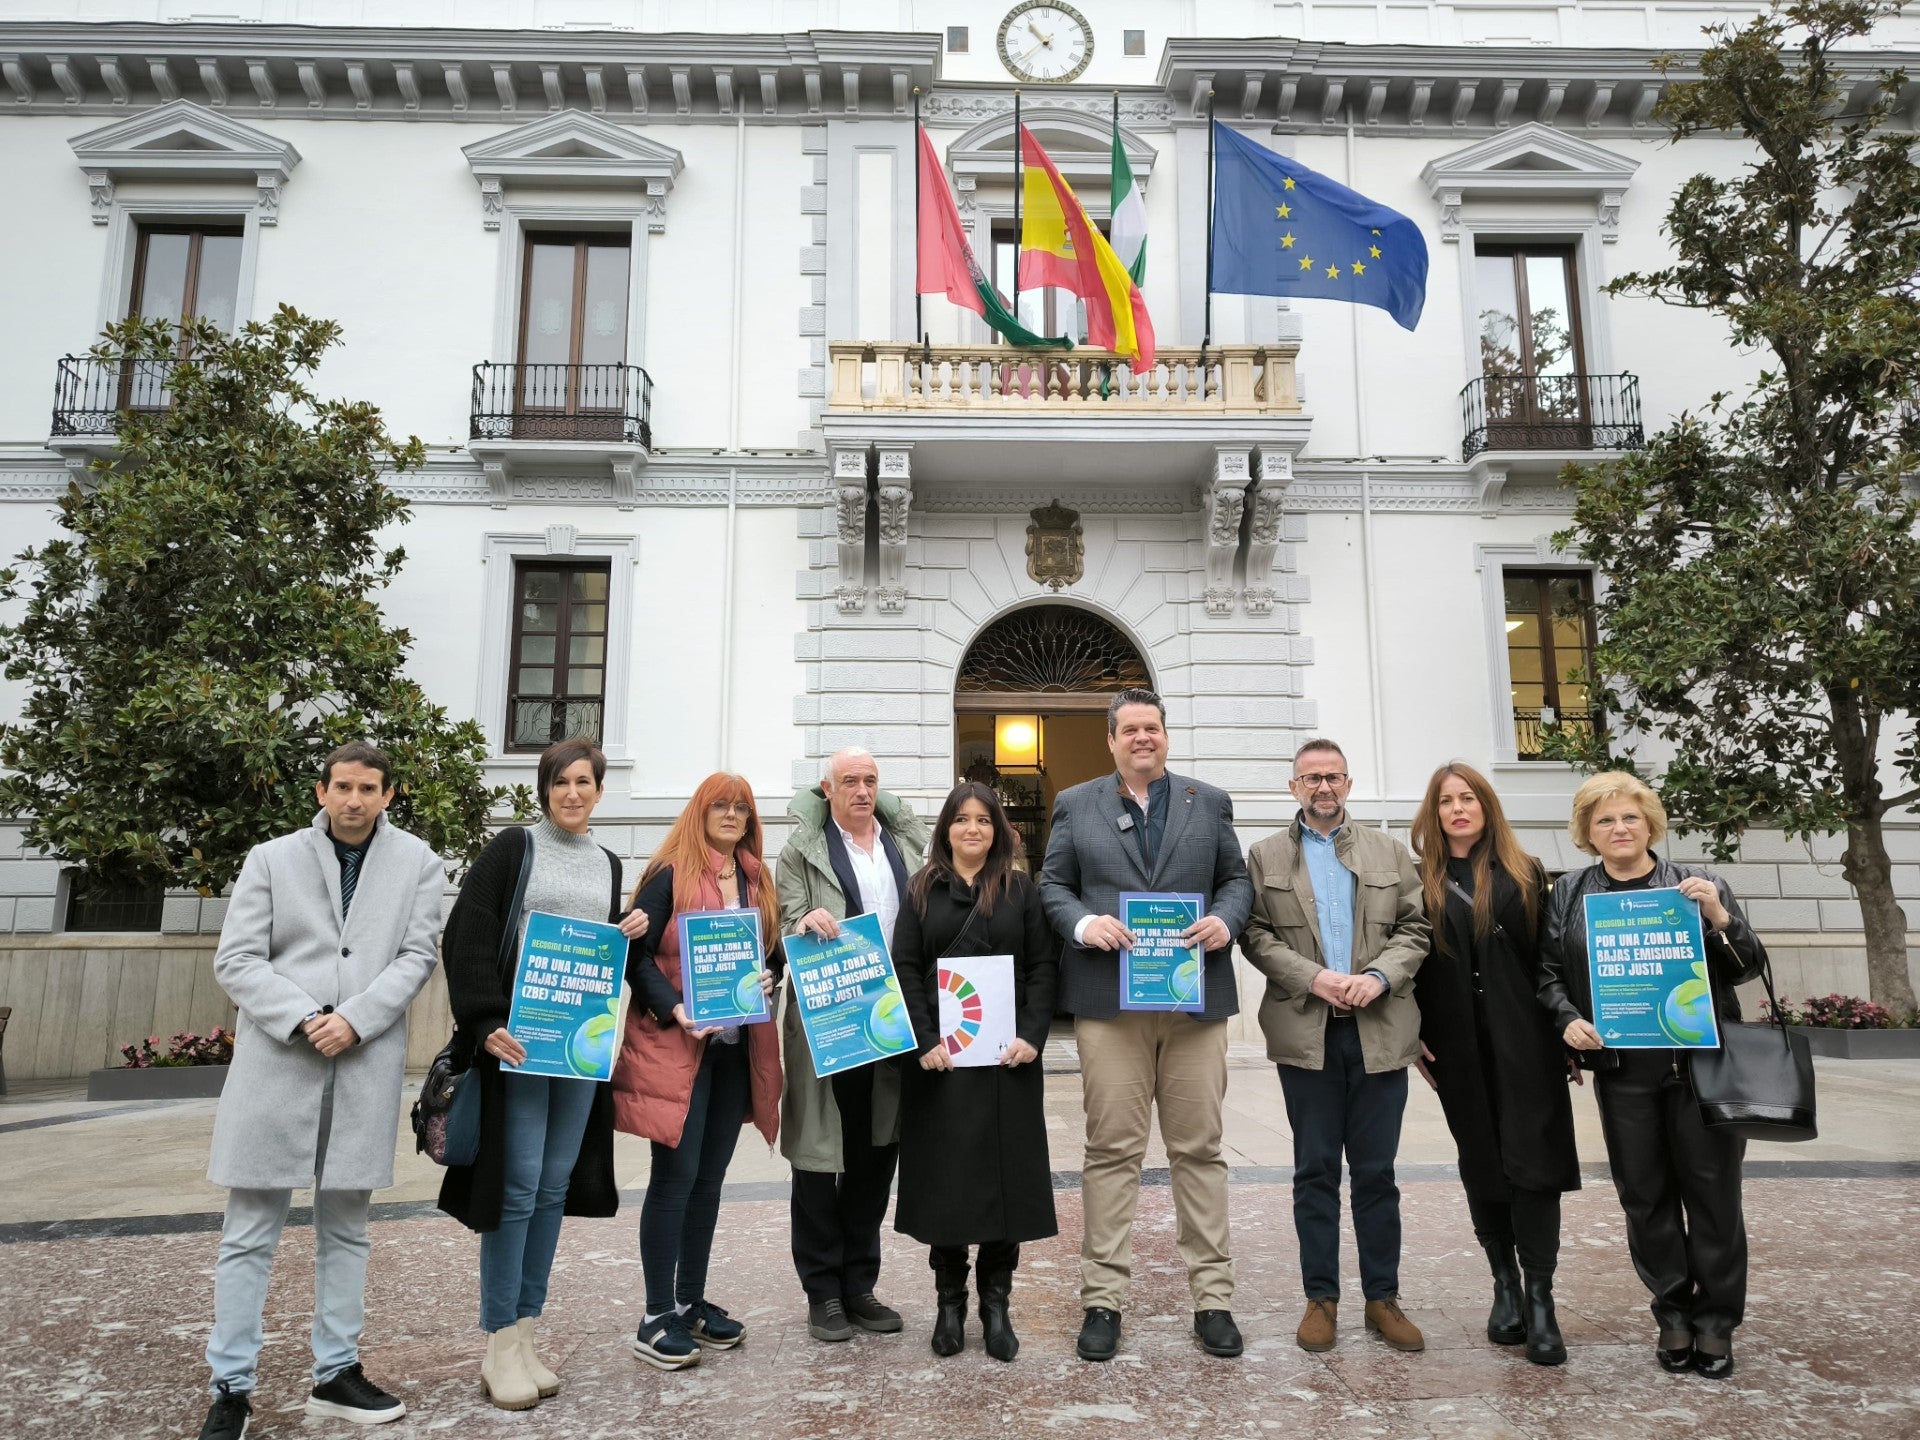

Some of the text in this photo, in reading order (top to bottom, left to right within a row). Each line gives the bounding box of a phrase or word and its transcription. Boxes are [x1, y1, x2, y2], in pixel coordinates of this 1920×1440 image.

[1595, 918, 1625, 929] RECOGIDA
[1627, 918, 1635, 926] DE
[1637, 916, 1662, 926] FIRMAS
[531, 939, 562, 952] RECOGIDA
[563, 944, 572, 952] DE
[572, 945, 596, 957] FIRMAS
[693, 941, 752, 954] POR UNA ZONA DE
[1596, 931, 1690, 948] POR UNA ZONA DE
[694, 951, 754, 964] BAJAS EMISIONES
[1132, 948, 1173, 957] (ZBE) JUSTA
[1596, 946, 1694, 962] BAJAS EMISIONES
[528, 955, 614, 980] POR UNA ZONA DE
[695, 962, 736, 974] (ZBE) JUSTA
[799, 951, 881, 984] POR UNA ZONA DE
[1598, 962, 1663, 977] (ZBE) JUSTA
[524, 970, 613, 995] BAJAS EMISIONES
[802, 964, 886, 997] BAJAS EMISIONES
[522, 986, 582, 1006] (ZBE) JUSTA
[806, 984, 863, 1010] (ZBE) JUSTA
